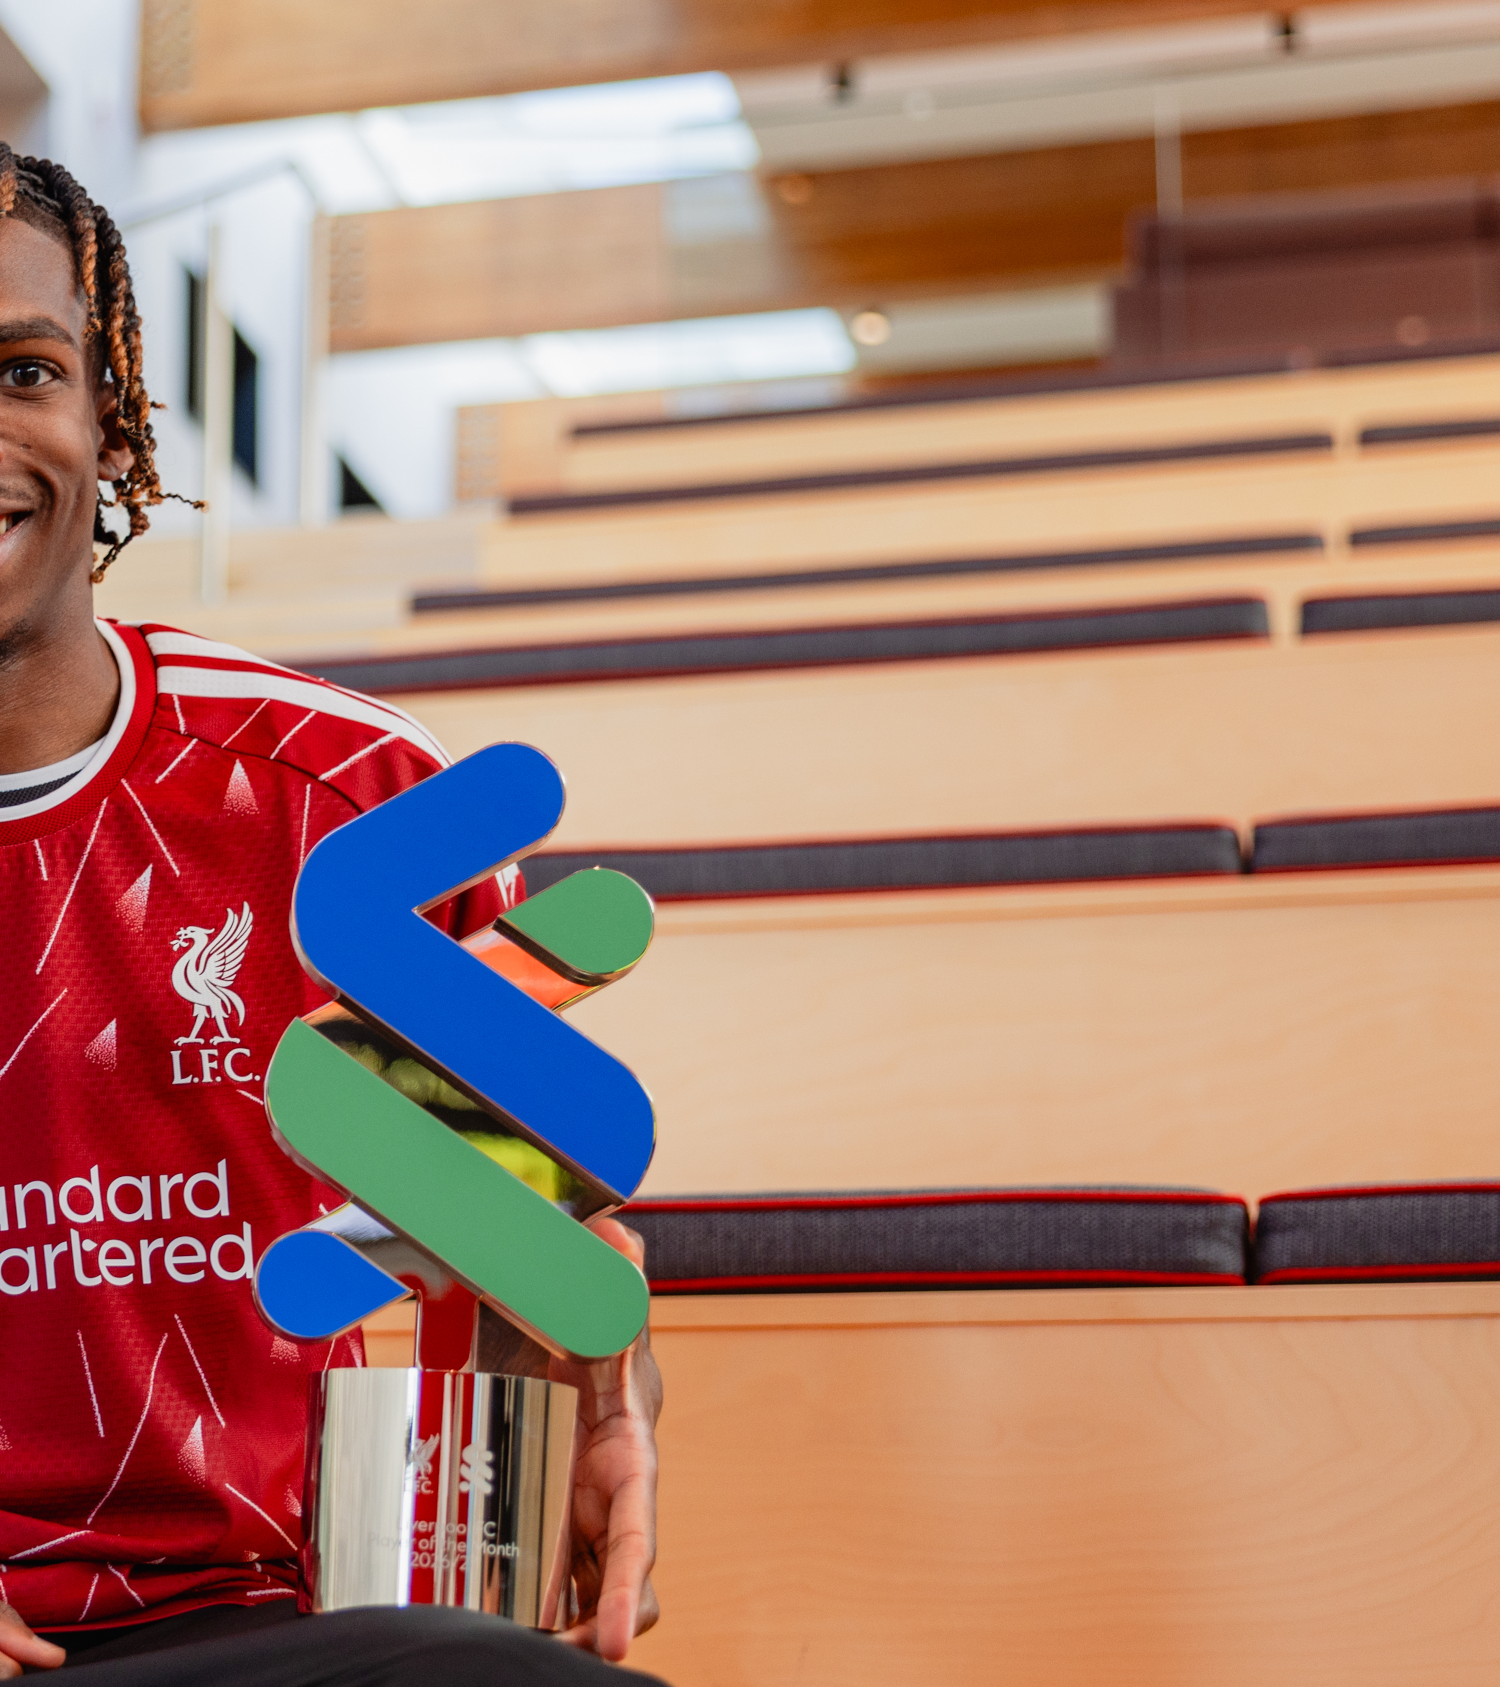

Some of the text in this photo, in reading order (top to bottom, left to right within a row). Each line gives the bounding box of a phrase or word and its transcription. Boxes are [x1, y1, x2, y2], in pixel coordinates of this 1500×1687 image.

[169, 1047, 261, 1085] L.F.C.
[367, 1531, 416, 1551] Playr
[441, 1535, 467, 1552] he
